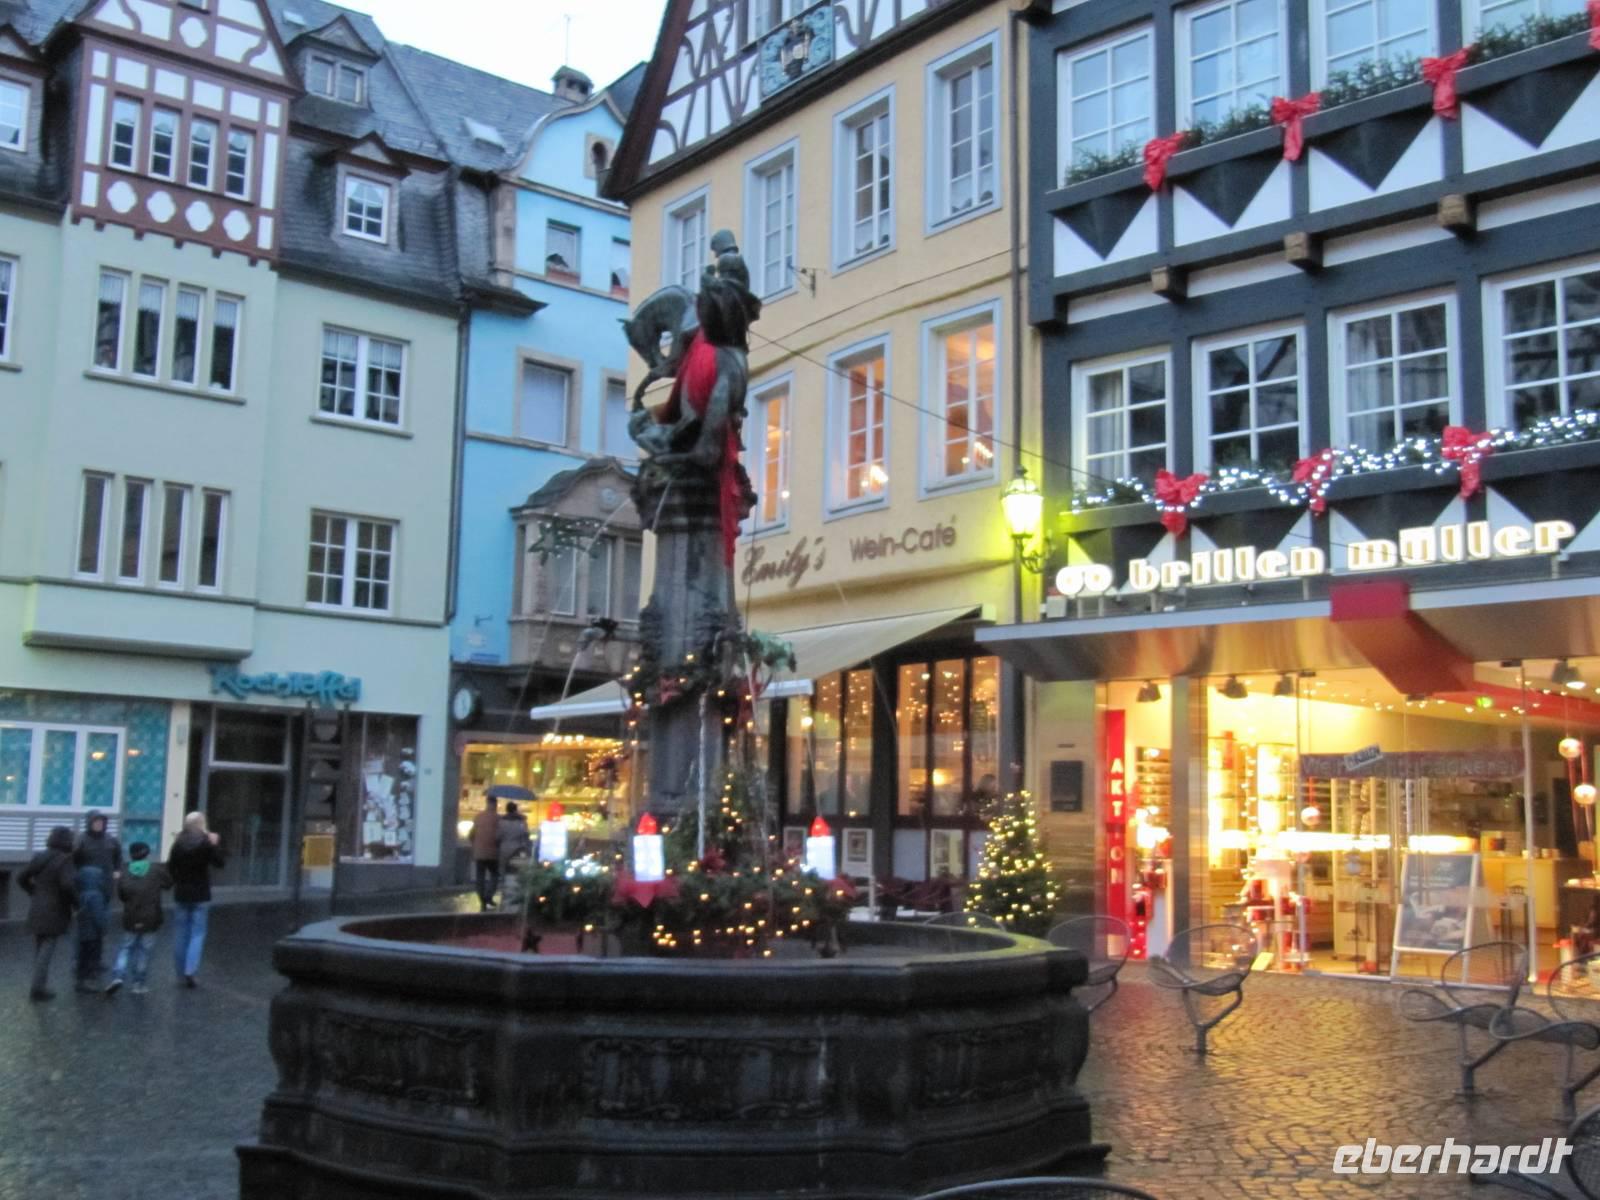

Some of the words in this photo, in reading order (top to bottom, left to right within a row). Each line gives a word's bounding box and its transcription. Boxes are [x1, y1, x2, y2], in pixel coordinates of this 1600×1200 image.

[741, 536, 826, 588] Emily's
[1129, 546, 1325, 592] brillen
[1348, 519, 1576, 572] müller
